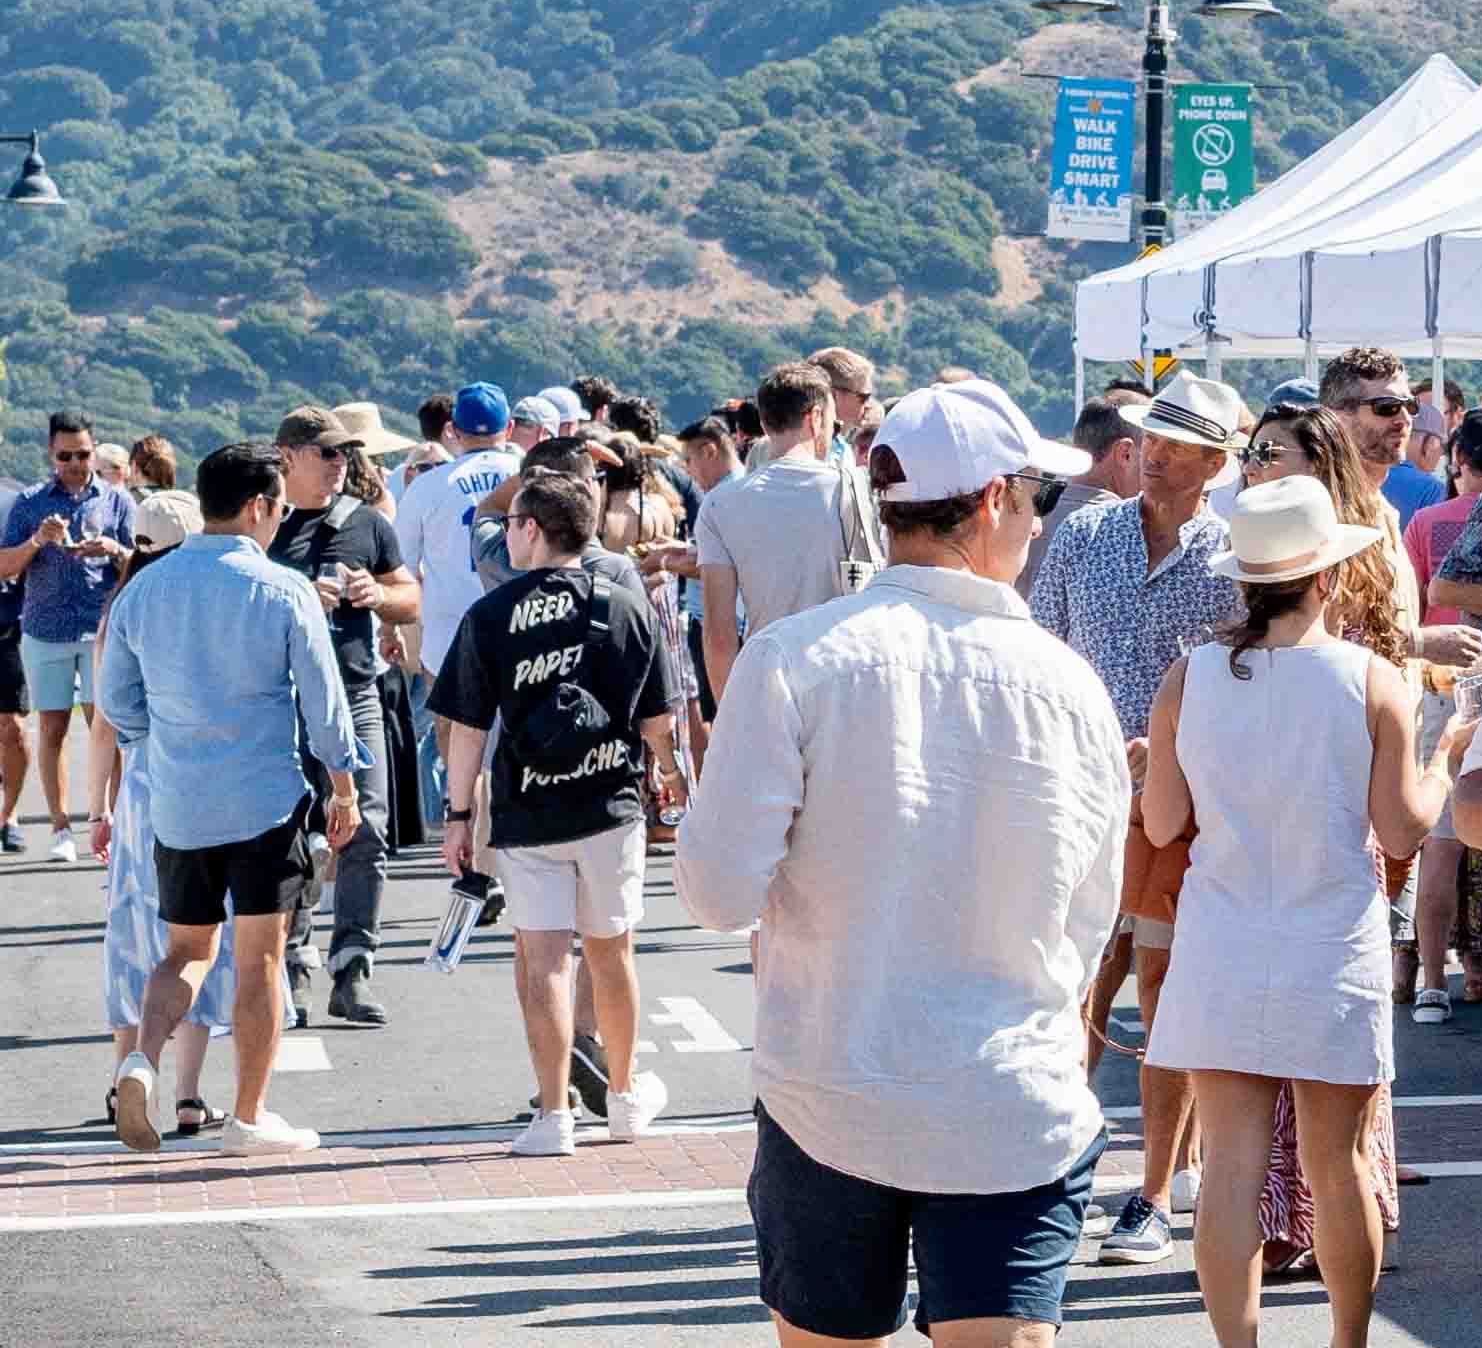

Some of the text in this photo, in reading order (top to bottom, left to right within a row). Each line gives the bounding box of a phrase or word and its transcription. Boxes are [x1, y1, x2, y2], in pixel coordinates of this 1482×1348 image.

[1190, 95, 1217, 107] EYES
[1178, 108, 1248, 121] PHONE DOWN
[1072, 117, 1118, 134] WALK
[1075, 136, 1113, 152] BIKE
[1068, 152, 1119, 171] DRIVE
[1063, 171, 1121, 189] SMART
[456, 472, 504, 495] OHTA
[508, 590, 575, 635] NEED
